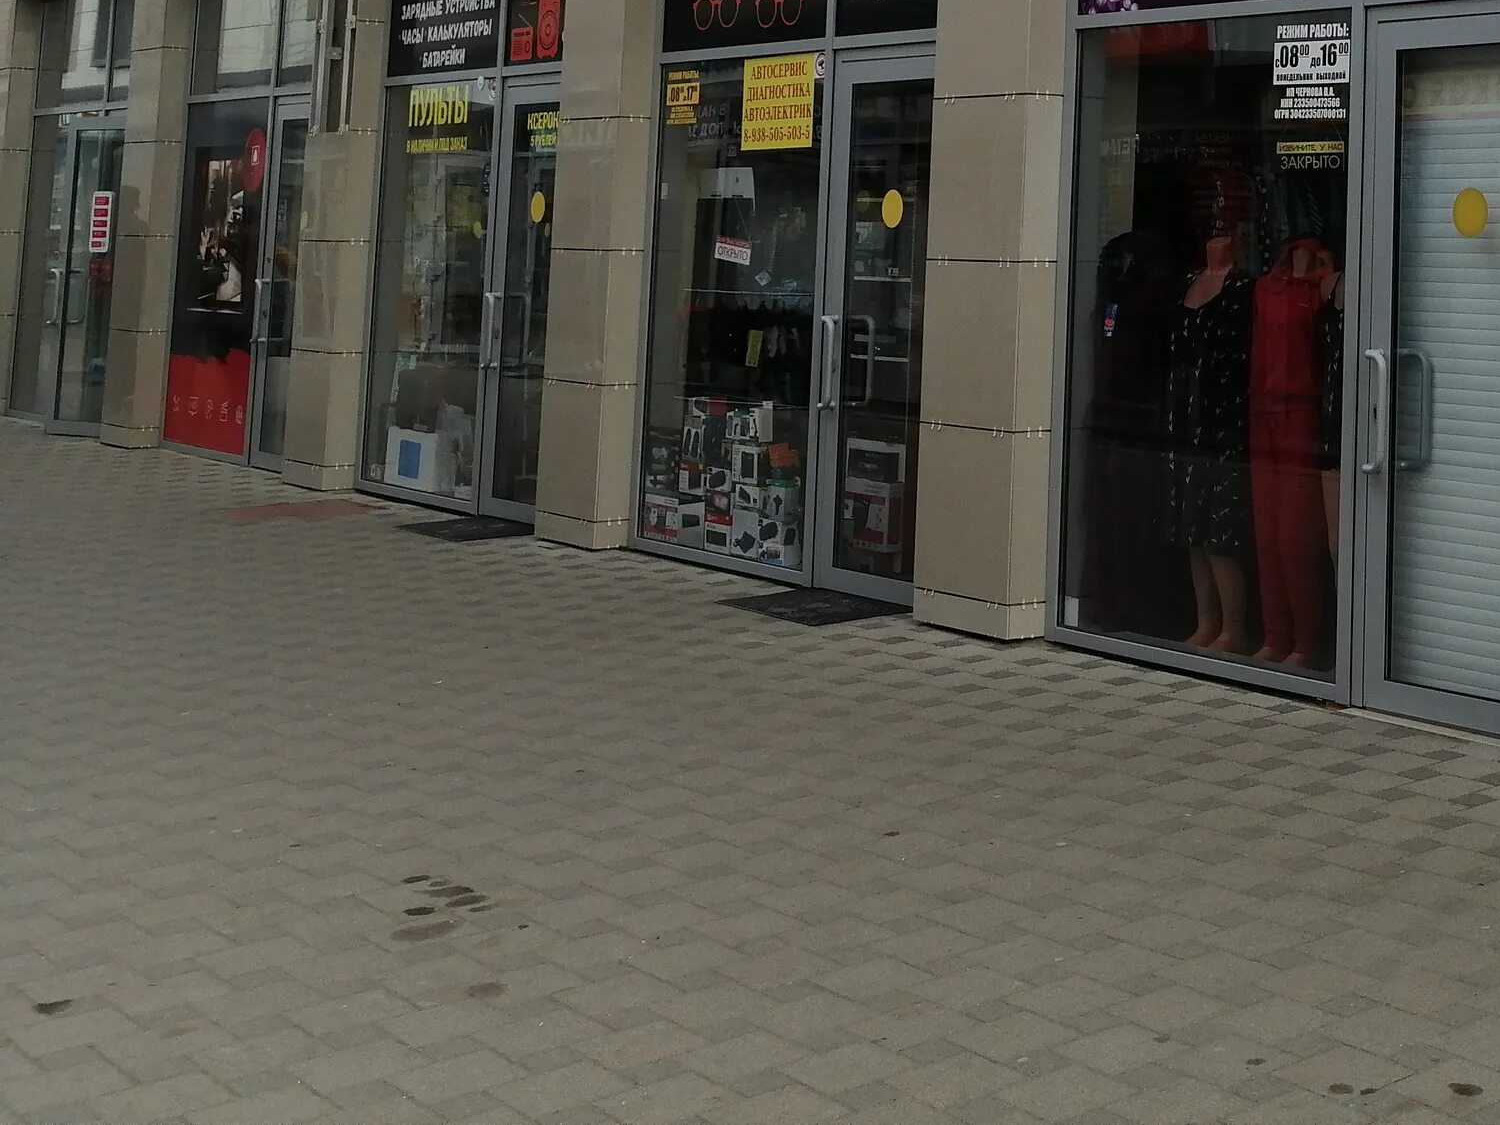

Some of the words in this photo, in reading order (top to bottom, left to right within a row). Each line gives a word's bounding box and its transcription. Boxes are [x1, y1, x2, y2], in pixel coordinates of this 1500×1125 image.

[401, 0, 443, 21] ЗАРЯДНЫЕ
[402, 27, 424, 45] ЧАСЫ
[427, 19, 492, 43] КАЛЬКУЛЯТОРЫ
[1277, 24, 1309, 39] РЕЖИМ
[1310, 23, 1350, 38] РАБОТЫ:
[422, 44, 466, 69] БАТАРЕЙКИ
[751, 61, 808, 80] АВТОСЕРВИС
[746, 83, 810, 102] ДИАГНОСТИКА
[408, 85, 468, 127] ПУЛЬТЫ
[744, 104, 812, 121] АВТОЭЛЕКТРИК
[1274, 109, 1289, 119] ОГРН
[744, 125, 810, 143] 8-938-505-503-5
[1328, 143, 1343, 151] НАС
[1280, 155, 1340, 170] ЗАКРЫТО
[718, 245, 748, 261] ОТКРЫТО
